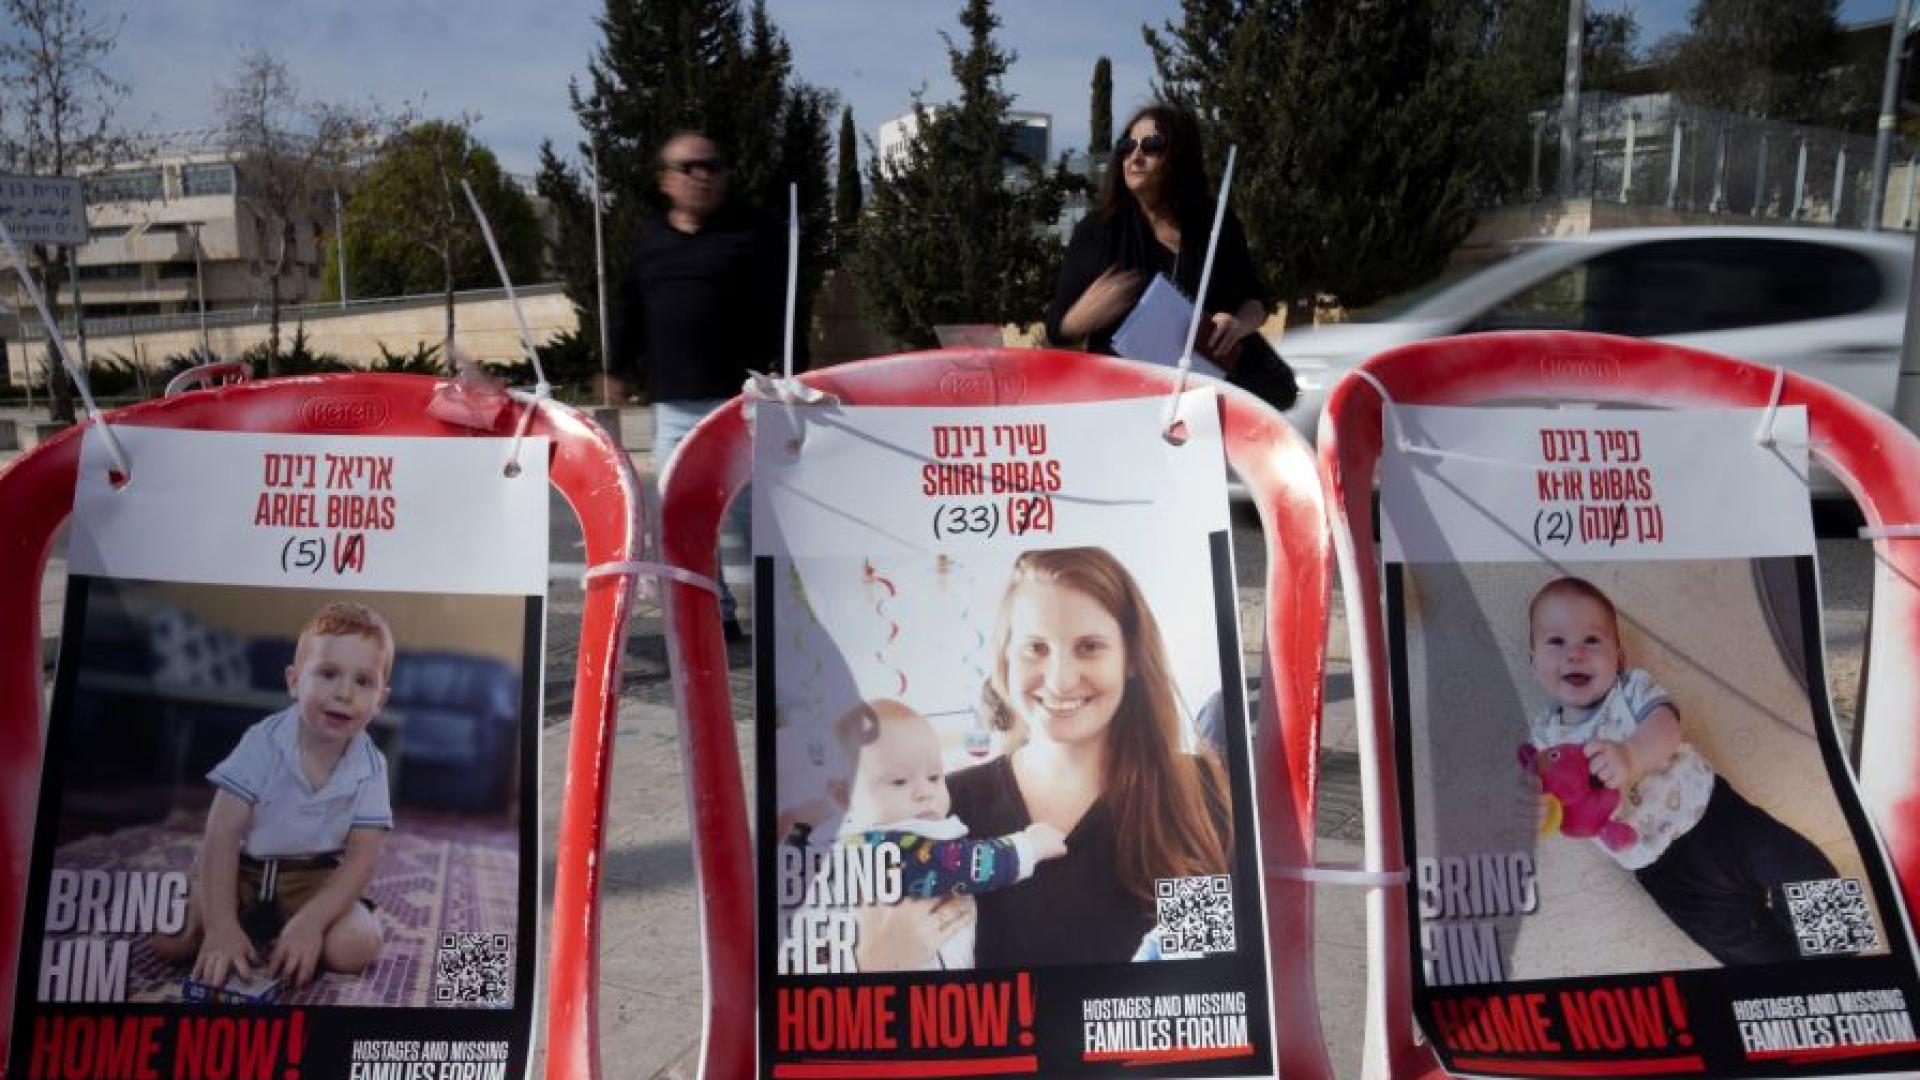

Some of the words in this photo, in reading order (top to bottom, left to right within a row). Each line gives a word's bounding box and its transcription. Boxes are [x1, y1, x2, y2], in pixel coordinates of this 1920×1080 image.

[932, 425, 986, 459] ביבס
[993, 424, 1047, 456] שירי
[1540, 430, 1590, 463] ביבס
[1594, 430, 1641, 462] כפיר
[264, 454, 316, 488] ביבס
[325, 453, 393, 489] אריאל
[923, 462, 984, 496] SHIRI
[991, 460, 1061, 493] BIBAS
[1590, 468, 1652, 501] BIBAS
[255, 492, 320, 528] ARIEL
[327, 495, 395, 530] BIBAS
[934, 504, 999, 540] (33)
[1534, 510, 1573, 546] (2)
[281, 536, 326, 574] (5)
[778, 842, 903, 907] BRING
[1418, 852, 1537, 918] BRING
[45, 870, 188, 933] BRING
[778, 910, 858, 975] HER
[1421, 922, 1503, 986] HIM
[37, 938, 130, 1003] HIM
[778, 984, 897, 1052] HOME
[909, 972, 1035, 1048] NOW!
[1083, 996, 1151, 1020] HOSTAGES
[1155, 995, 1181, 1017] AND
[1184, 992, 1246, 1016] MISSING
[1432, 992, 1560, 1053] HOME
[1559, 976, 1694, 1049] NOW!
[1732, 996, 1807, 1021] HOSTAGES
[1806, 994, 1838, 1016] AND
[1838, 989, 1906, 1013] MISSING
[28, 1015, 165, 1080] HOME
[173, 1010, 305, 1080] NOW!
[352, 1040, 421, 1061] HOSTAGES
[423, 1040, 449, 1061] AND
[451, 1040, 509, 1061] MISSING
[1084, 1019, 1171, 1053] FAMILIES
[1176, 1015, 1248, 1048] FORUM
[1739, 1016, 1835, 1054] FAMILIES
[1834, 1011, 1917, 1047] FORUM
